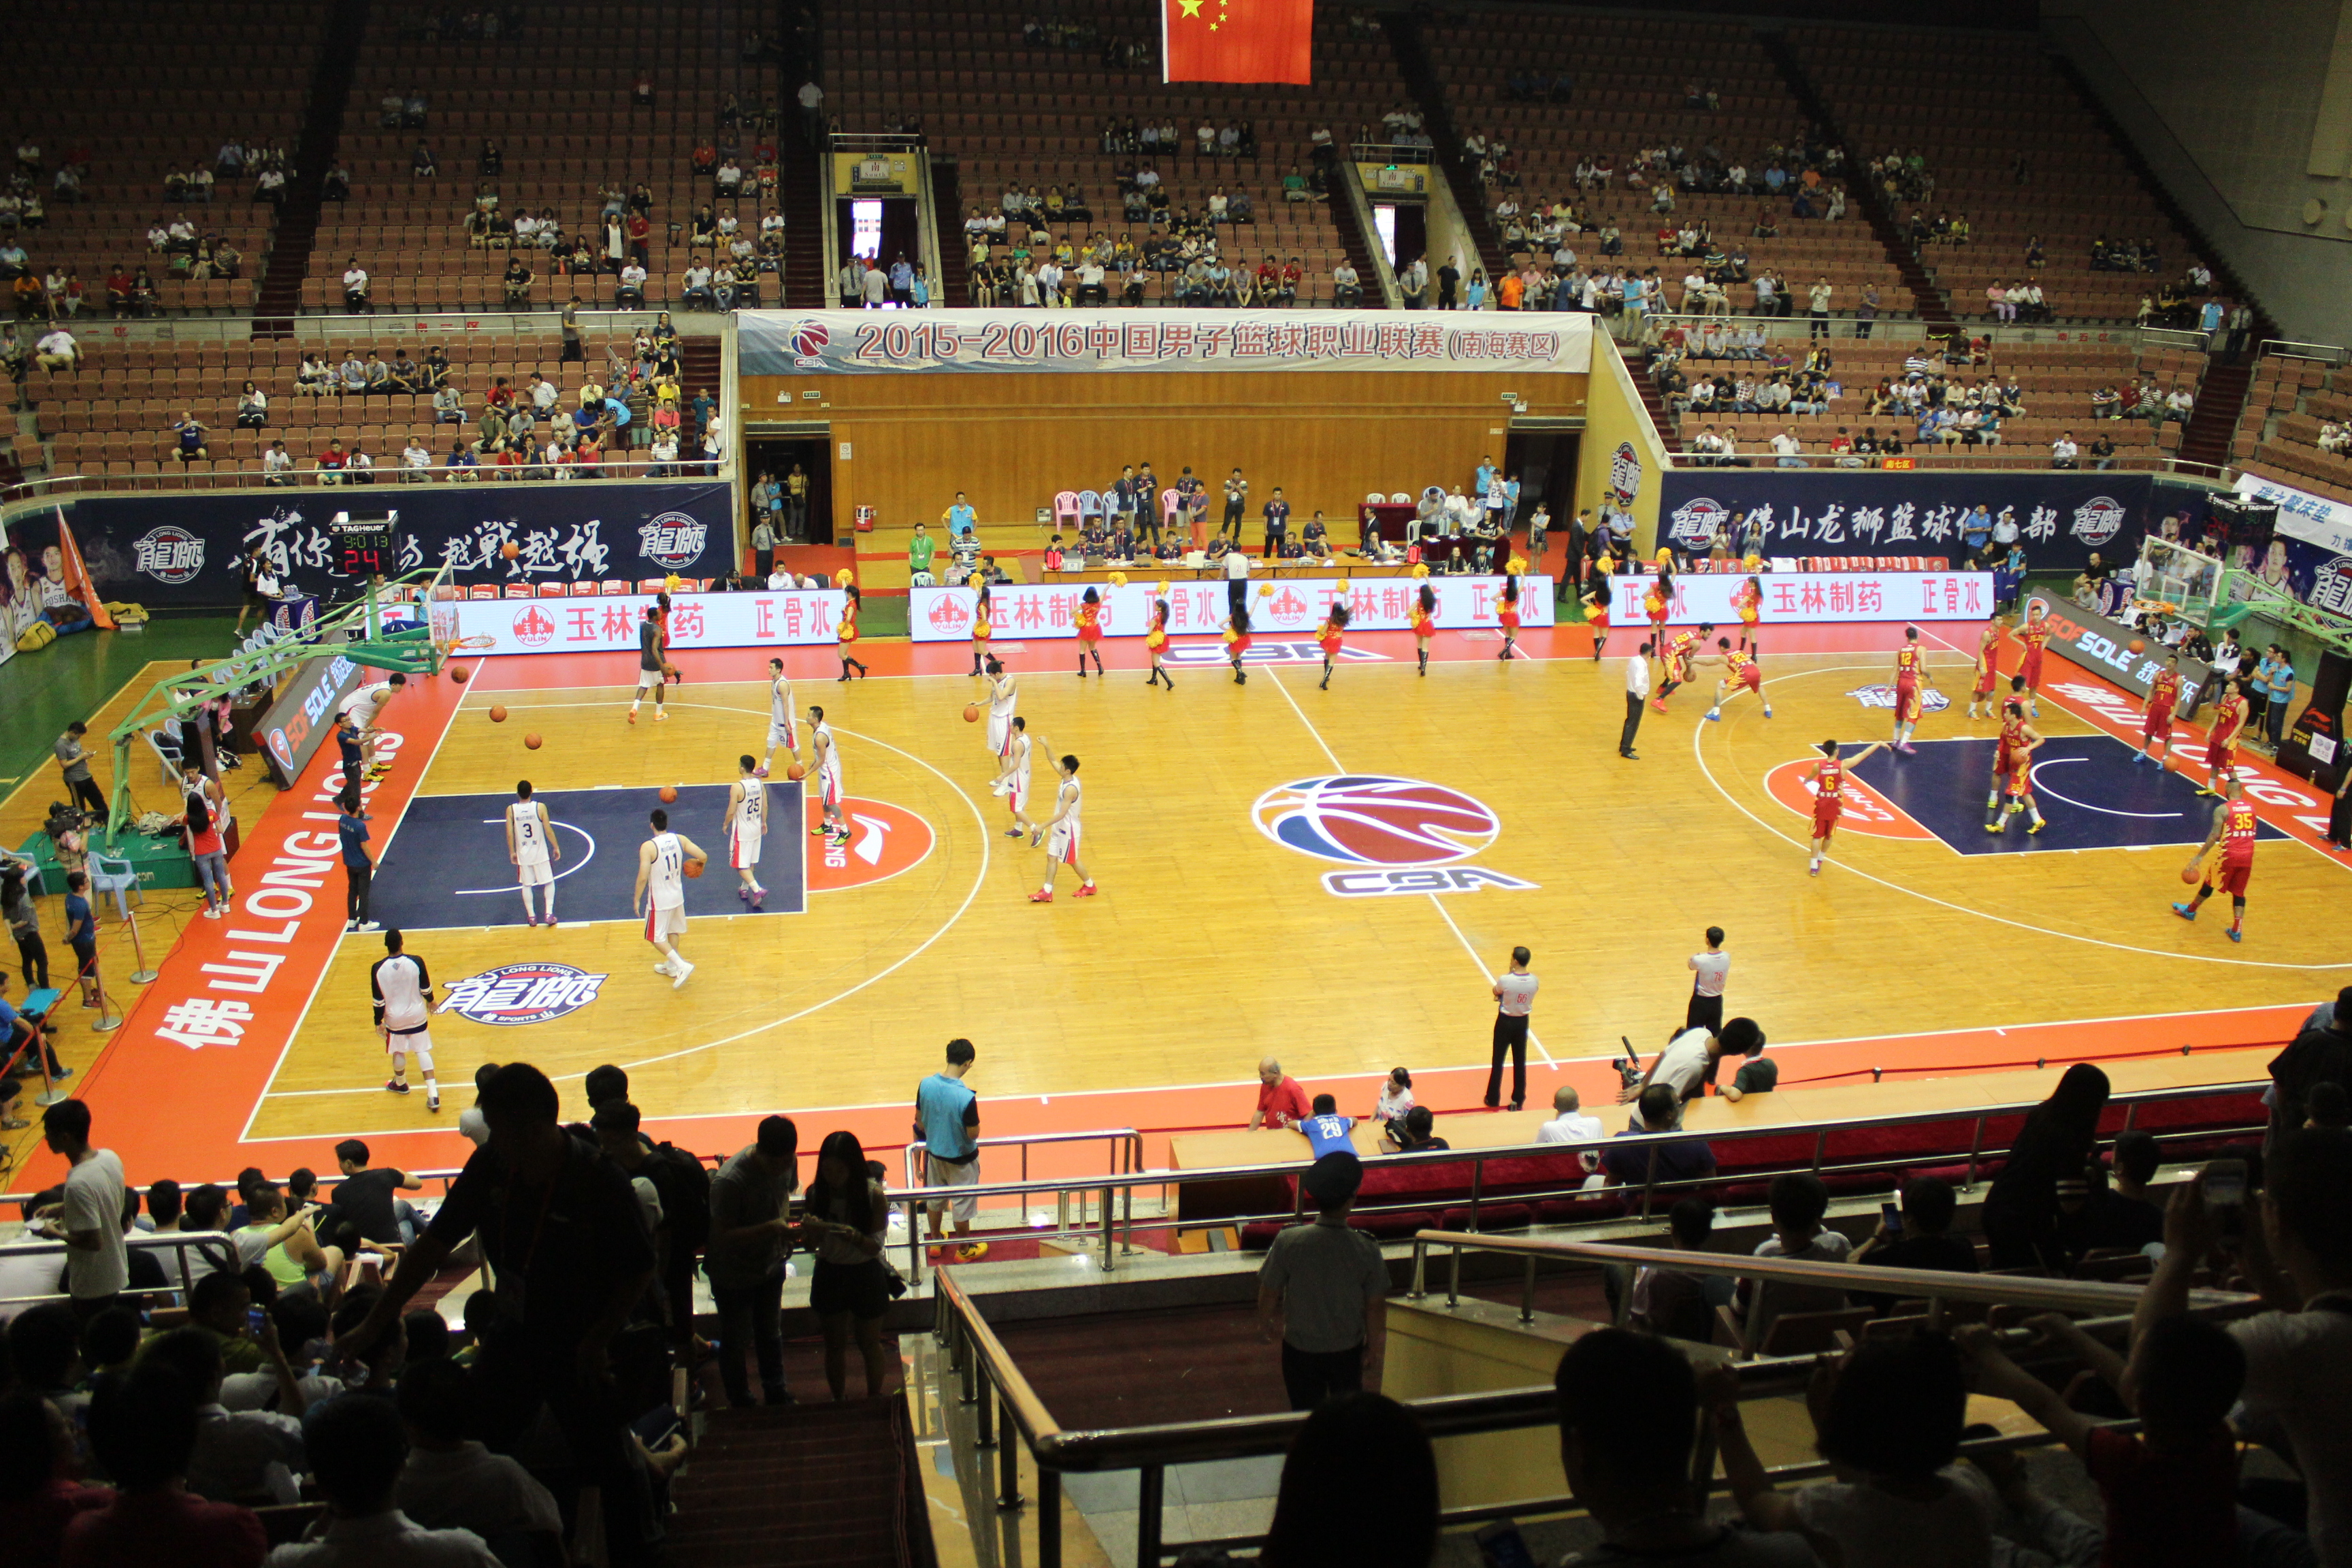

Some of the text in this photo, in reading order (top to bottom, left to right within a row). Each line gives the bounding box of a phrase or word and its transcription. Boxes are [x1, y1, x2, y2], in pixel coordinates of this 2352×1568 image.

[794, 357, 829, 368] CBA
[1886, 459, 1911, 469] 南七区
[676, 517, 691, 527] LIONS
[1742, 502, 2058, 545] 佛山龙狮篮球部
[172, 532, 188, 541] LIONS
[344, 550, 380, 573] 24
[1472, 582, 1539, 620] 正水
[1623, 581, 1688, 619] 正水
[1772, 580, 1882, 614] 玉林制药
[1922, 578, 1981, 613] 正骨水
[566, 597, 830, 642] 玉林药 正骨水
[1901, 652, 1912, 666] 12
[1825, 775, 1835, 791] 6
[747, 797, 761, 815] 25
[2234, 813, 2253, 830] 35
[523, 823, 533, 838] 3
[665, 853, 678, 872] 11
[225, 831, 343, 944] LONG
[1320, 866, 1543, 898] CBA
[501, 966, 574, 976] LONG LIONS
[1714, 971, 1723, 982] 78
[1517, 994, 1528, 1004] 56
[540, 1011, 555, 1019] 山
[1320, 1122, 1343, 1140] 29
